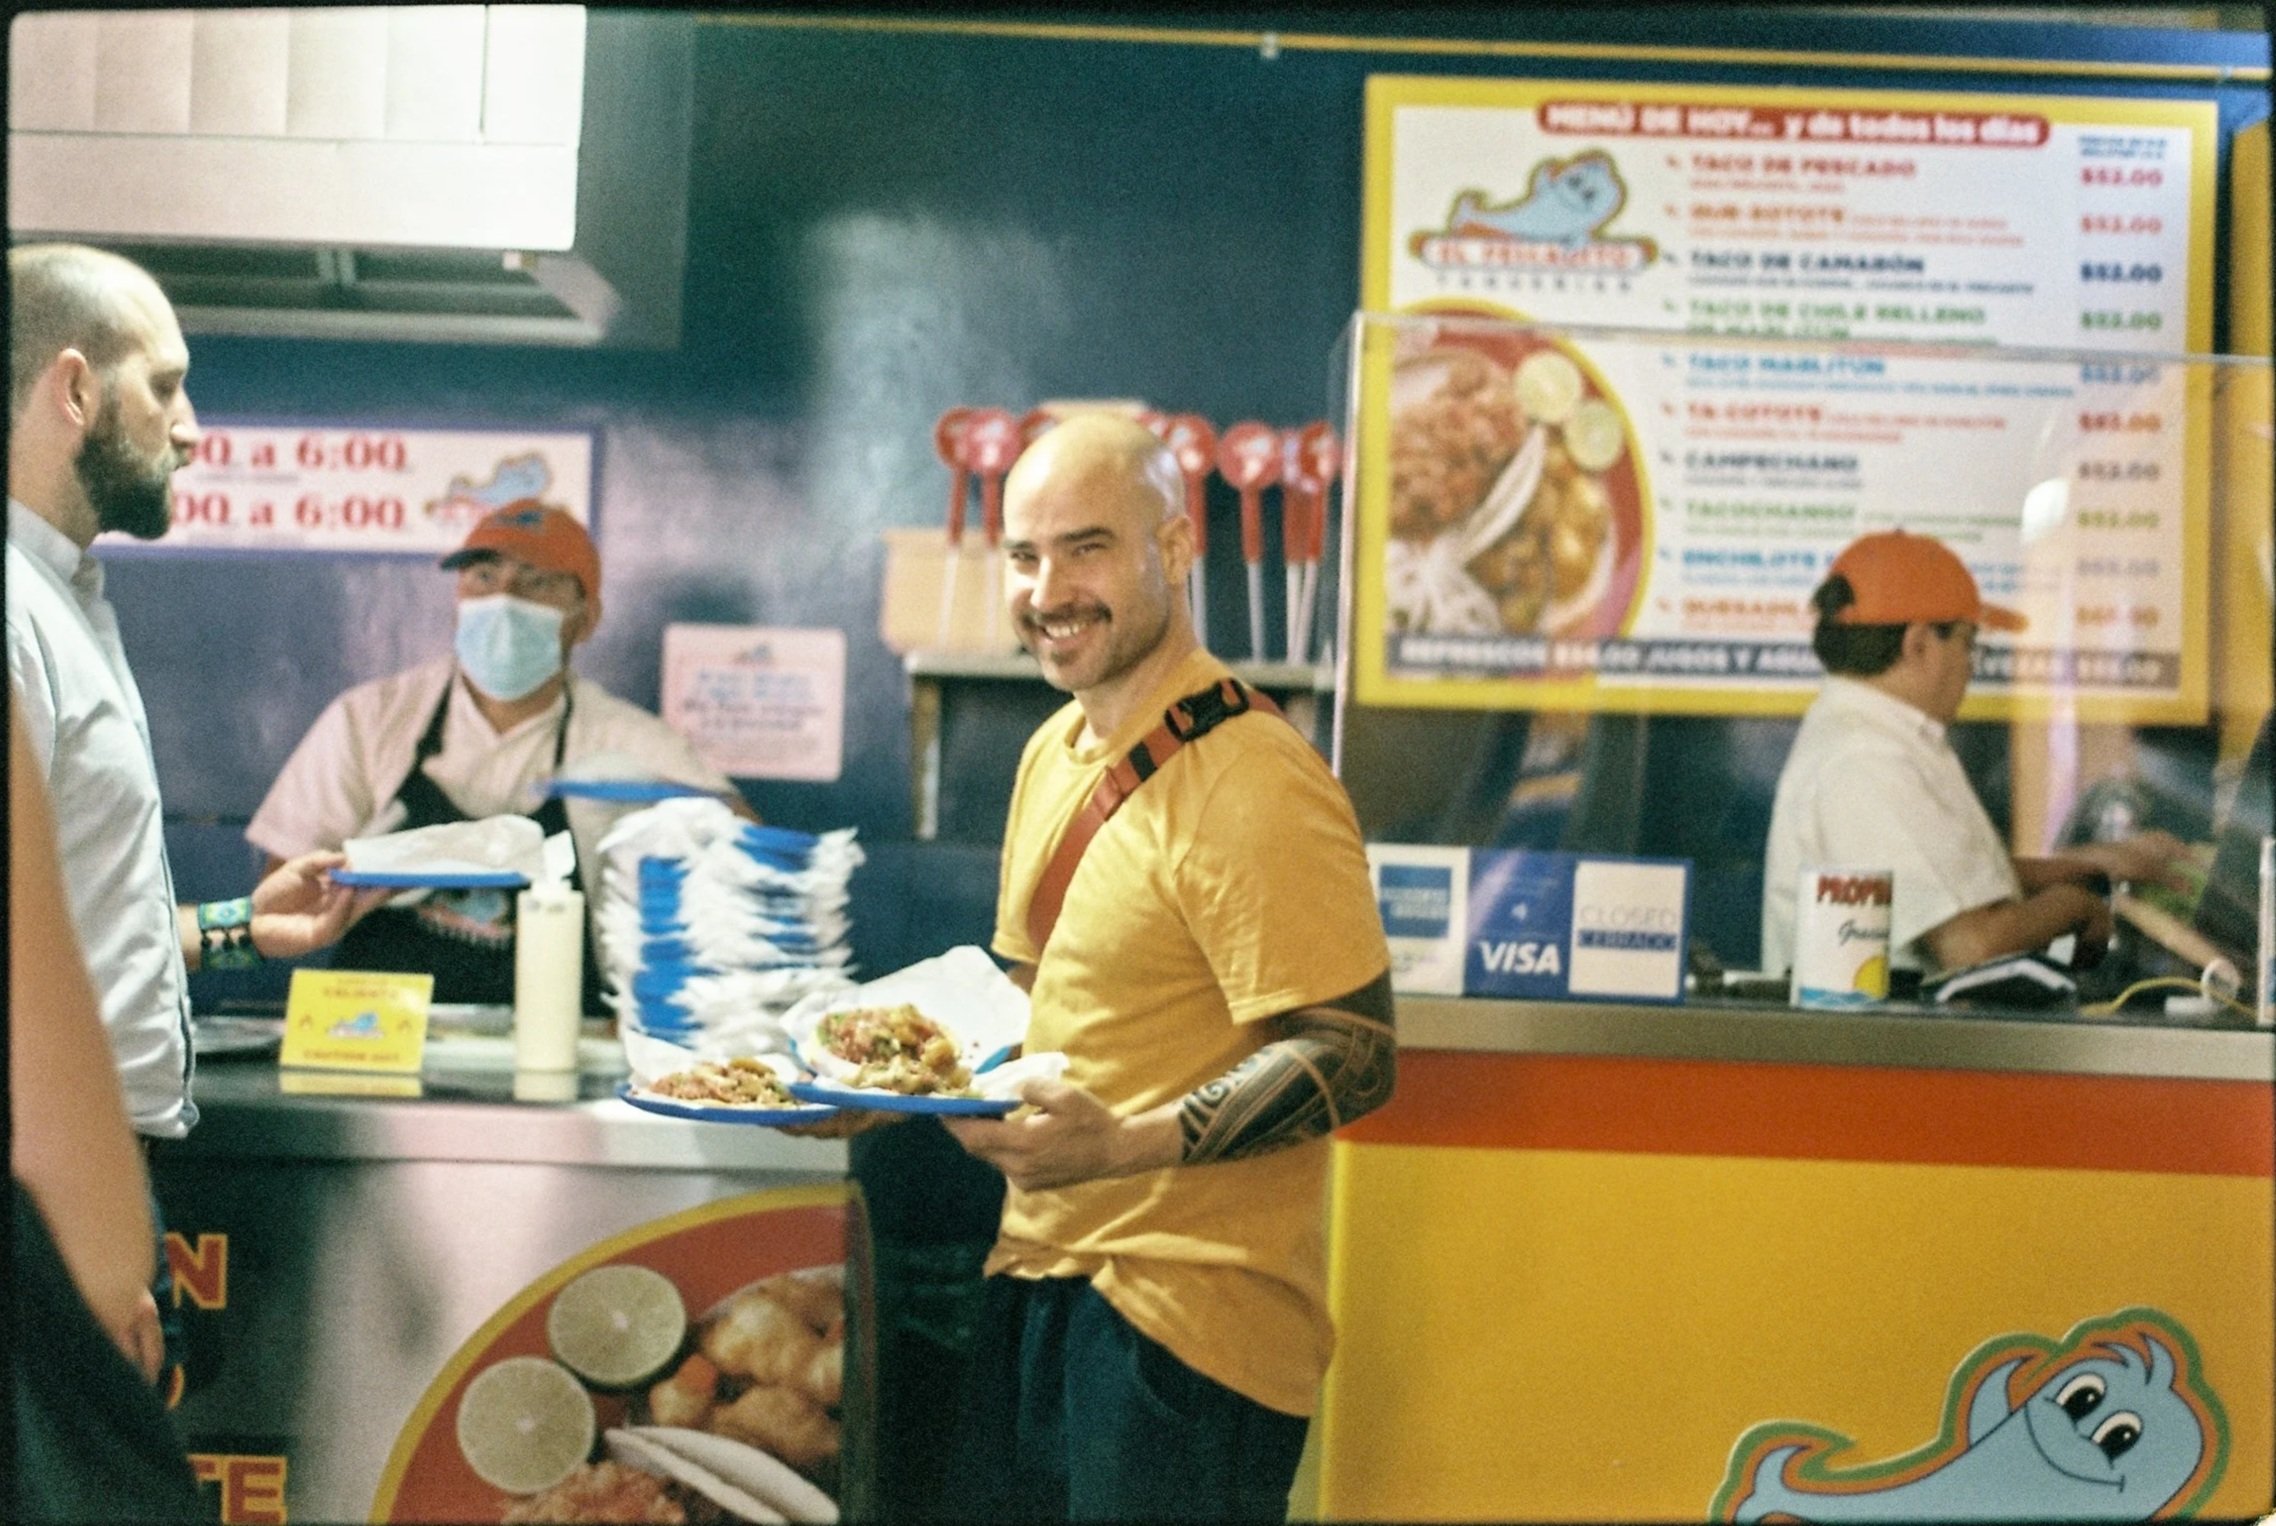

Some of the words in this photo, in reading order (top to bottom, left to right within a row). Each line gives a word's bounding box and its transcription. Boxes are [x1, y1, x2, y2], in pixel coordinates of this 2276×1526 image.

[1641, 106, 1680, 129] DE
[1785, 114, 1801, 138] y
[1807, 111, 1844, 137] de
[1850, 111, 1930, 139] todos
[1933, 112, 1974, 140] los
[1762, 156, 1791, 174] DE
[1760, 253, 1790, 270] DE
[1760, 302, 1790, 319] DE
[249, 441, 276, 467] a
[297, 432, 408, 472] 6:00
[249, 502, 276, 527] a
[295, 493, 406, 530] 6:00
[1734, 646, 1755, 674] Y
[1479, 941, 1561, 976] VISA
